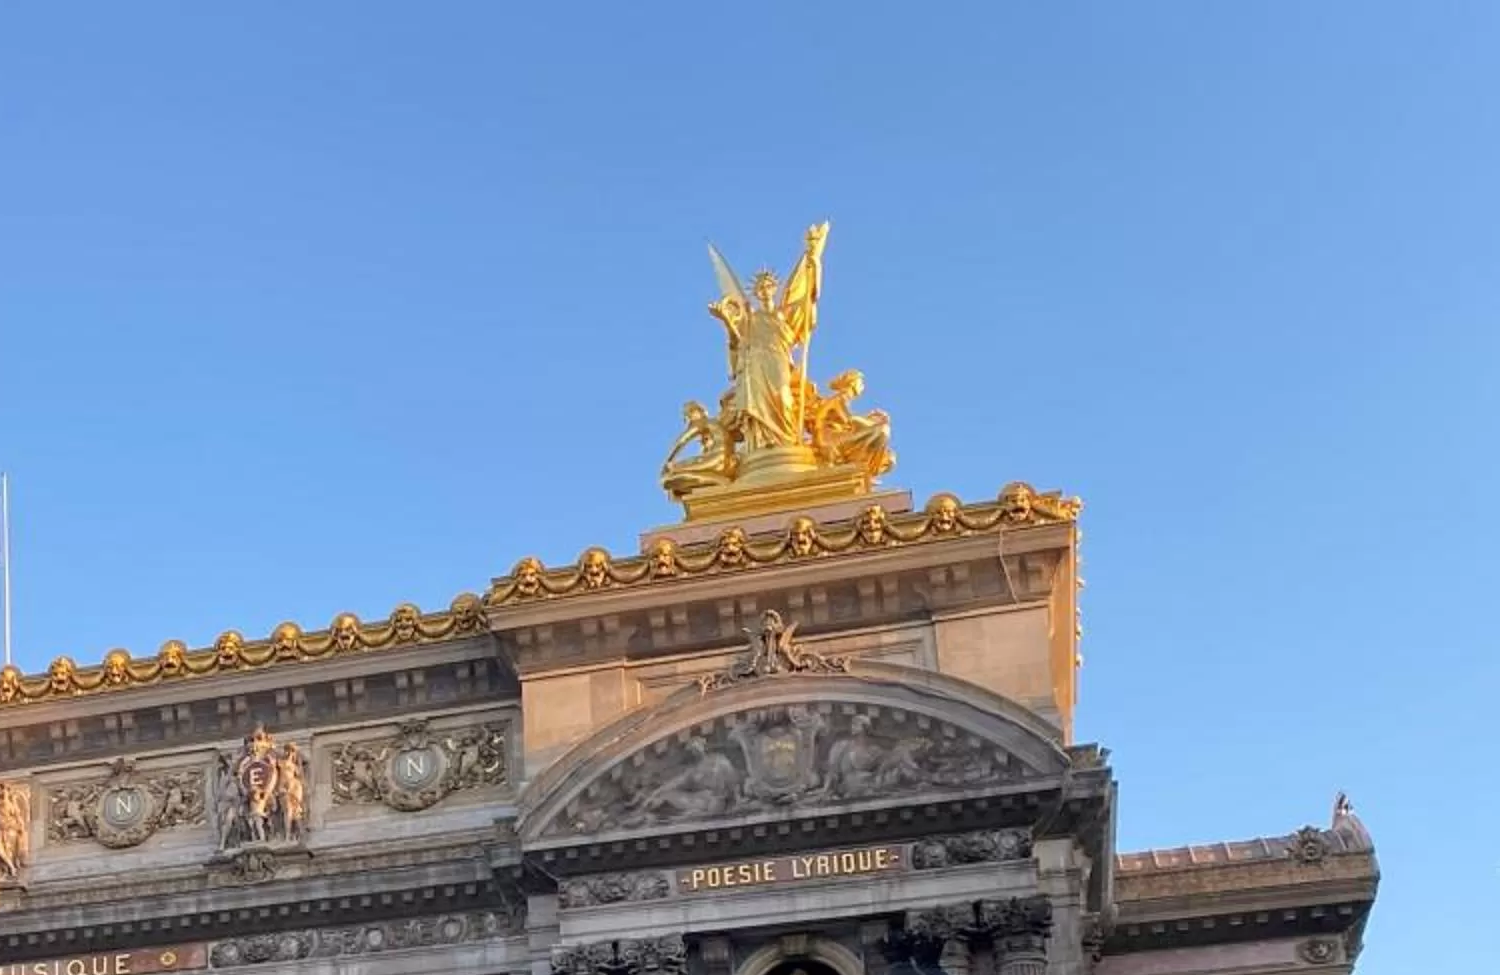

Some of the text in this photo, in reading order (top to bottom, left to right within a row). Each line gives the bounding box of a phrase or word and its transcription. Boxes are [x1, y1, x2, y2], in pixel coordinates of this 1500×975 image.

[251, 768, 262, 784] E
[407, 756, 423, 777] N
[117, 796, 131, 814] N
[692, 849, 887, 889] POESIE LYRIQUE
